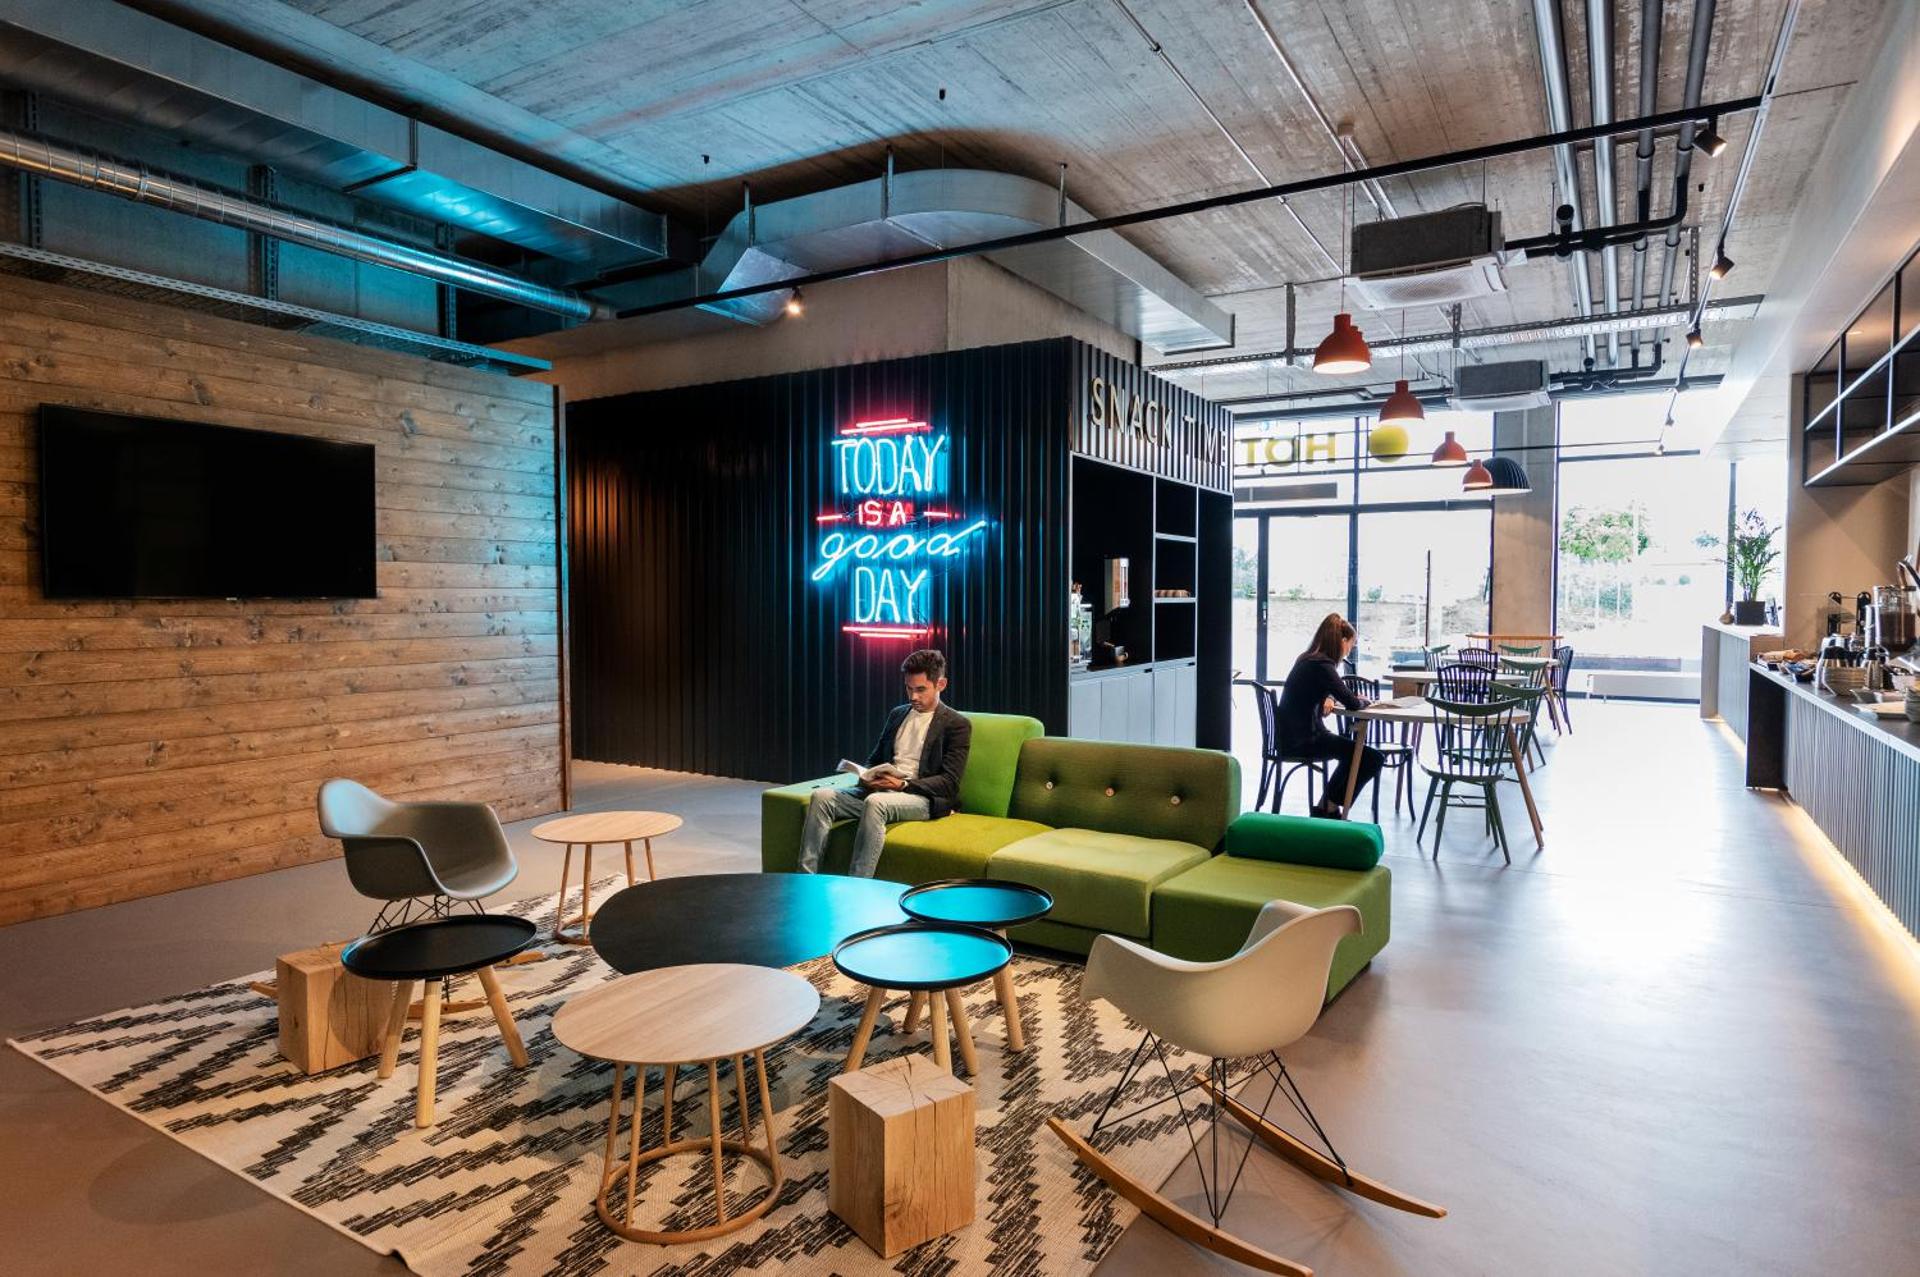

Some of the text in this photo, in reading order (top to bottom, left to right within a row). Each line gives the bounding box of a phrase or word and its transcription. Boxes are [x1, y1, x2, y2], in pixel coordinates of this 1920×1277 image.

[1089, 377, 1172, 449] SNACK
[831, 434, 945, 494] TODAY
[858, 501, 907, 526] IS A
[812, 520, 987, 580] good
[855, 566, 927, 624] DAY
